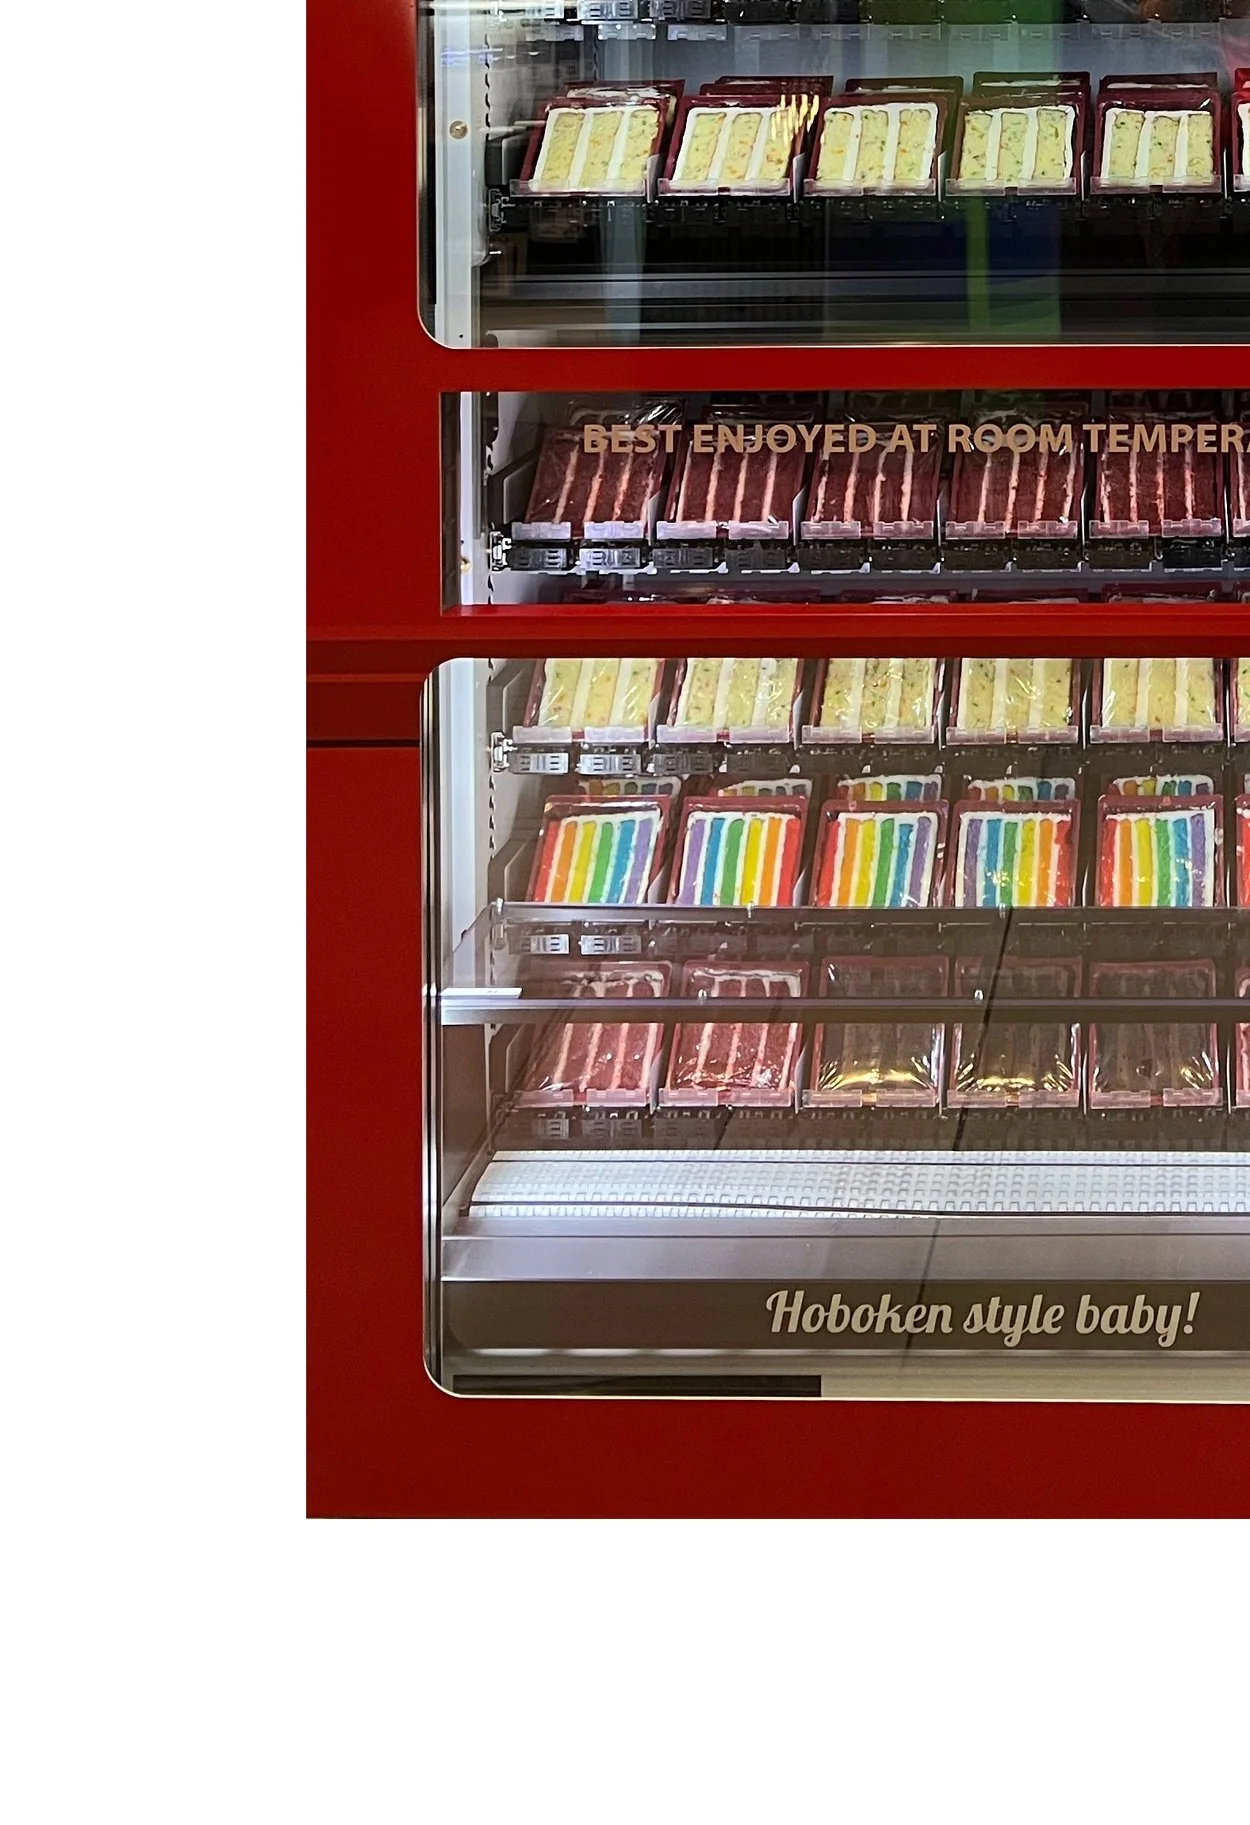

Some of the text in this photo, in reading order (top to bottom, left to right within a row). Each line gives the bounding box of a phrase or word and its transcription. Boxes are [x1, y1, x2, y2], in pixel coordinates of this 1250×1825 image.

[583, 424, 682, 455] BEST
[693, 424, 878, 455] ENJOYED
[885, 424, 937, 454] AT
[947, 424, 1073, 455] ROOM
[765, 1290, 1201, 1348] Hoboken style baby!
